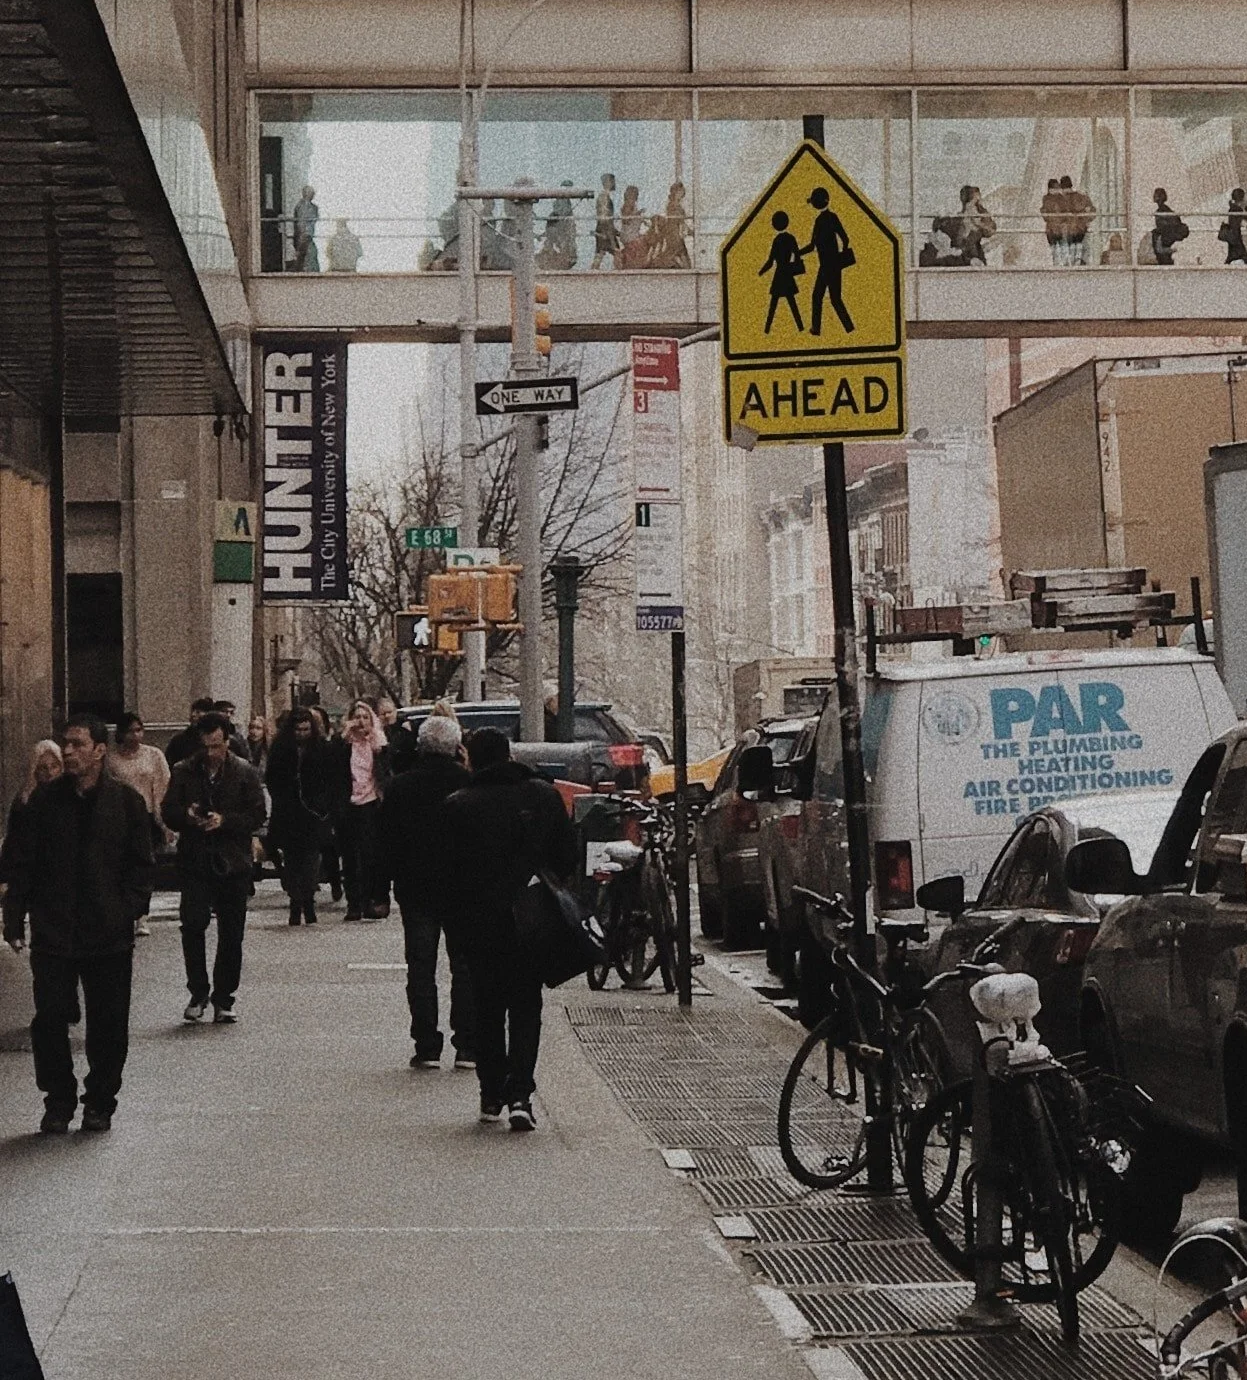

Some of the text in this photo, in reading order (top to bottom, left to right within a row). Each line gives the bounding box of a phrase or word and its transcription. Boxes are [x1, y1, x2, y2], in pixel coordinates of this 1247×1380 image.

[490, 388, 565, 405] ONE WAY
[636, 390, 646, 412] 3
[739, 375, 890, 420] AHEAD
[263, 351, 313, 593] HUNTER
[320, 353, 340, 591] The City University of New York
[639, 504, 646, 526] 1
[411, 530, 419, 546] E
[424, 529, 441, 545] 68
[990, 681, 1132, 740] PAR
[980, 733, 1144, 760] THE PLUMBING
[1018, 753, 1115, 776] HEATING
[963, 768, 1174, 799] AIR CONDITIONING
[974, 797, 1021, 816] FIRE
